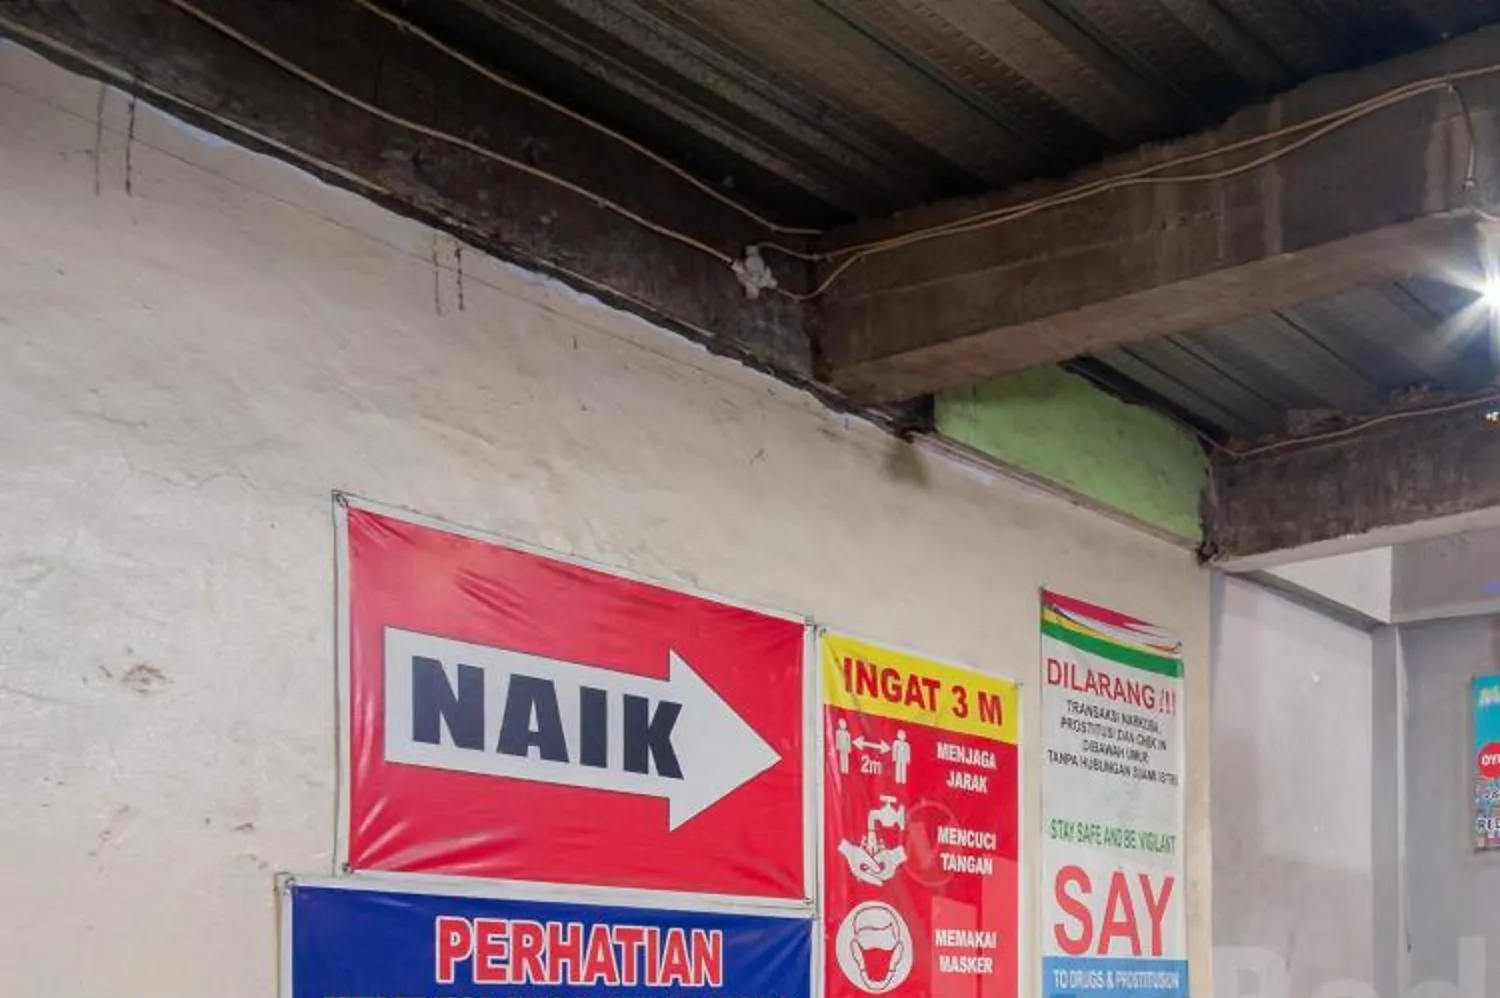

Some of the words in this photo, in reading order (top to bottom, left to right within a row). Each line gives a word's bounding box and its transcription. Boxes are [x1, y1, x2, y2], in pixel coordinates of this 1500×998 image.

[843, 656, 941, 713] INGAT
[951, 685, 969, 719] 3
[977, 691, 1003, 726] M
[412, 655, 685, 780] NAIK
[1066, 699, 1119, 723] TRANSAKSI
[1060, 716, 1116, 739] PROSTITUSI
[1117, 728, 1135, 743] DAN
[936, 741, 997, 769] MENJAGA
[1083, 739, 1125, 760] DIBAWAH
[860, 755, 883, 775] 2m
[1047, 749, 1079, 768] TANPA
[1080, 755, 1131, 778] HUBUNGAN
[945, 771, 988, 793] JARAK
[937, 826, 997, 850] MENCUCI
[1050, 818, 1075, 840] STAY
[1077, 821, 1101, 845] SAFE
[1103, 825, 1122, 847] AND
[1124, 829, 1137, 849] BE
[940, 852, 993, 875] TANGAN
[1053, 864, 1176, 957] SAY
[935, 929, 997, 949] MEMAKAI
[435, 916, 724, 987] PERHATIAN
[938, 955, 993, 974] MASKER
[1053, 970, 1069, 989] TO
[1069, 970, 1105, 989] DRUGS
